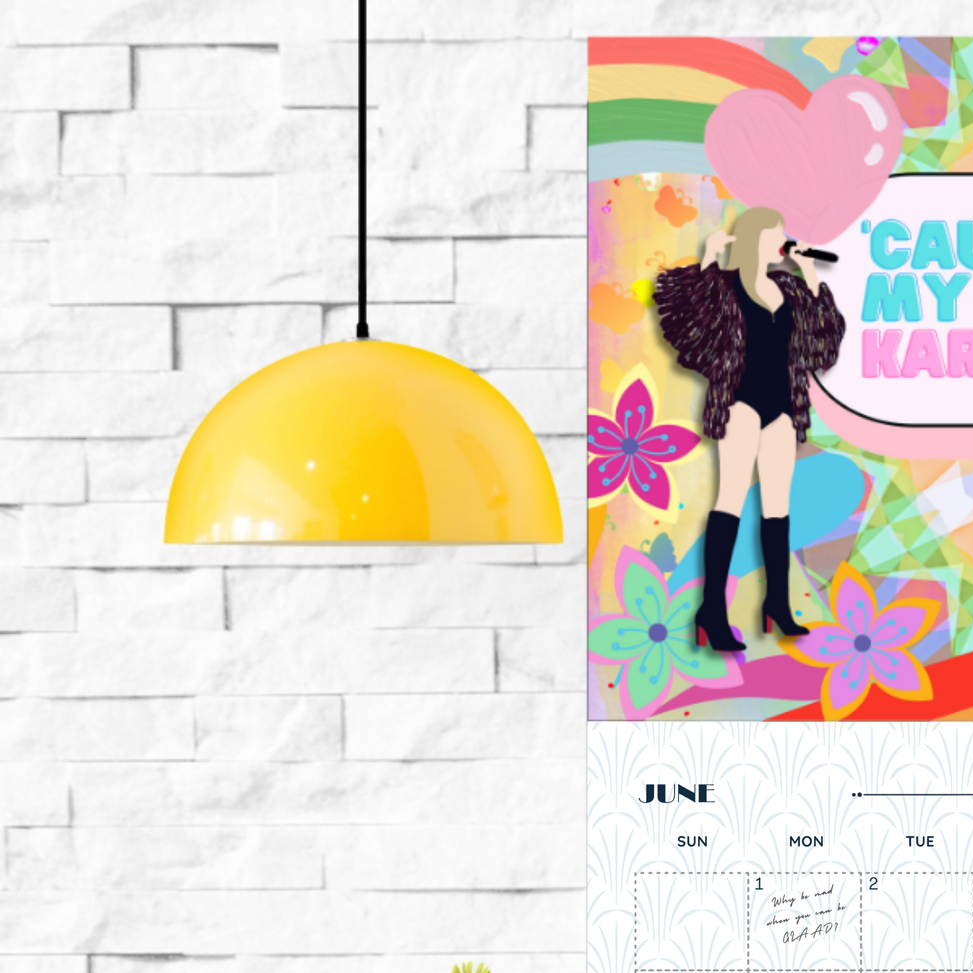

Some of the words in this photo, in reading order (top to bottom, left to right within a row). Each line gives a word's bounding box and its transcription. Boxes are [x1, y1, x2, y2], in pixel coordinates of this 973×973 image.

[860, 272, 971, 322] MY
[638, 783, 716, 804] JUNE
[677, 835, 708, 848] SUN
[789, 835, 824, 848] MON
[905, 835, 935, 848] TUE
[754, 877, 764, 891] 1
[868, 876, 879, 891] 2
[772, 894, 796, 907] Why
[801, 892, 809, 900] be
[767, 915, 790, 926] when
[795, 913, 810, 924] you
[837, 903, 846, 911] be
